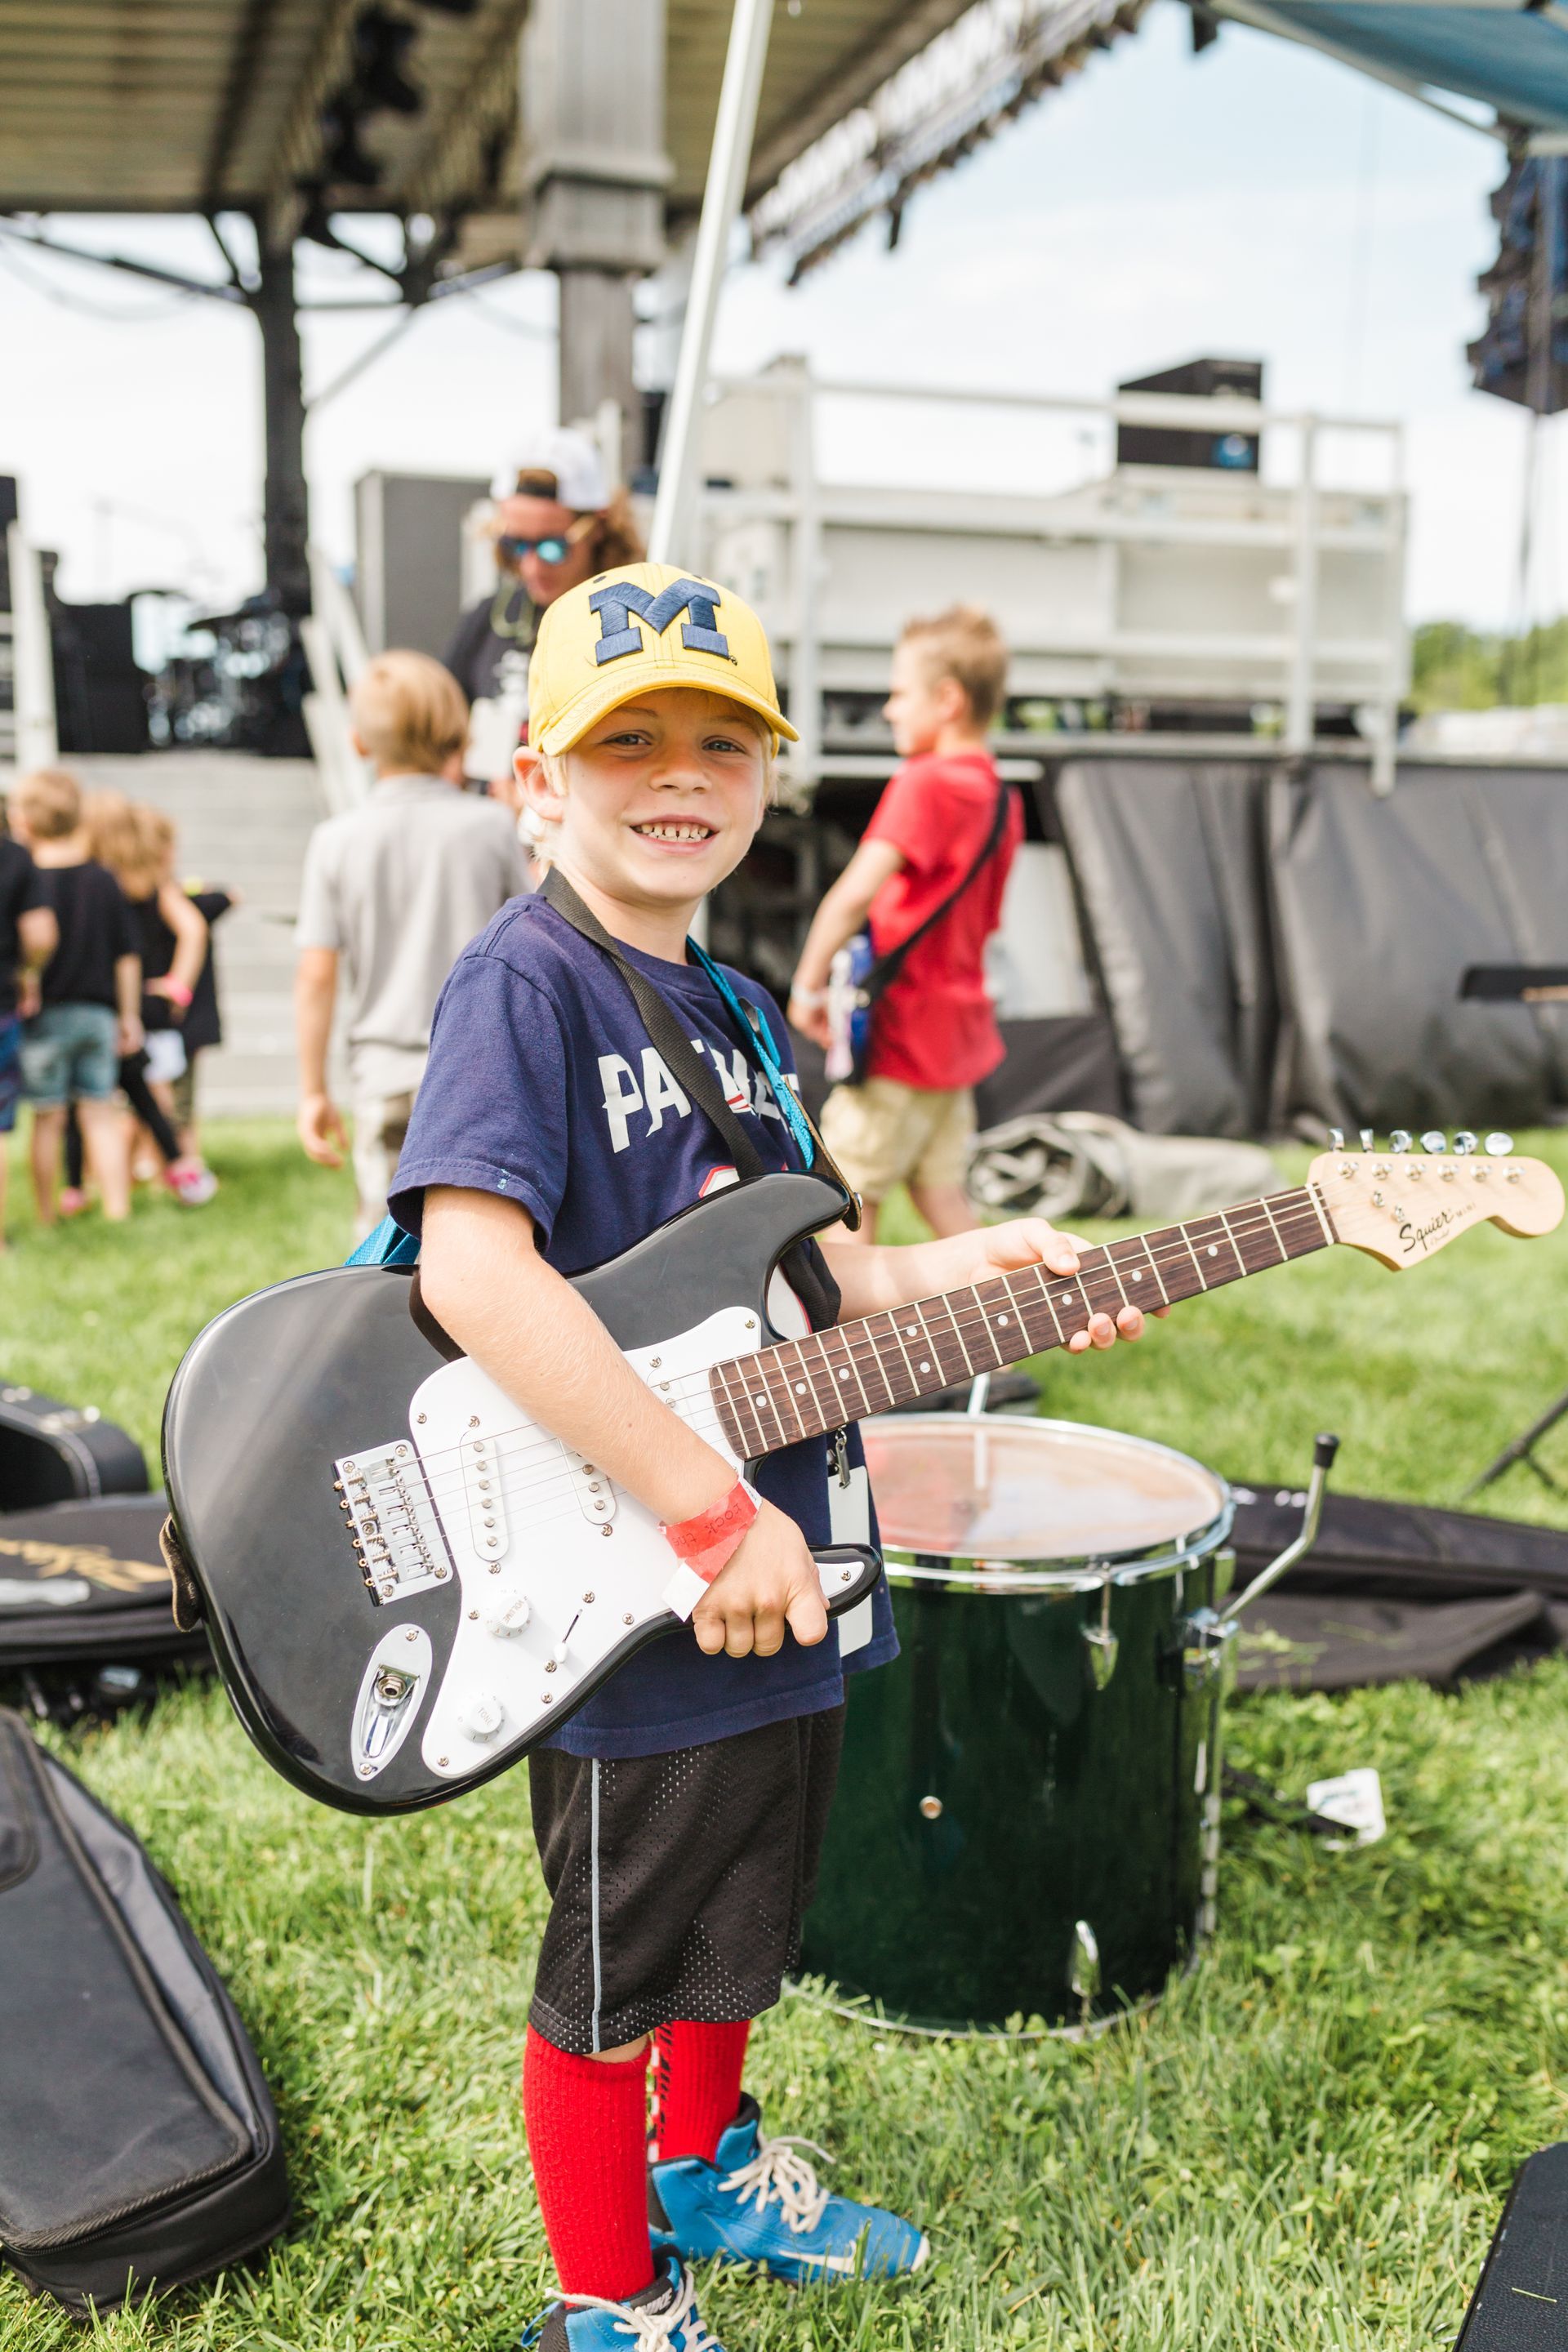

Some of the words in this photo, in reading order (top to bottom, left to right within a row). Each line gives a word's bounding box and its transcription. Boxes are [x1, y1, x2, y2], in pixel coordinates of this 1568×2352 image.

[589, 578, 729, 666] M
[1399, 1211, 1454, 1253] Squier
[705, 1503, 742, 1534] rock
[672, 1533, 697, 1548] the
[502, 1600, 524, 1624] VOLUME
[478, 1707, 493, 1726] TONE
